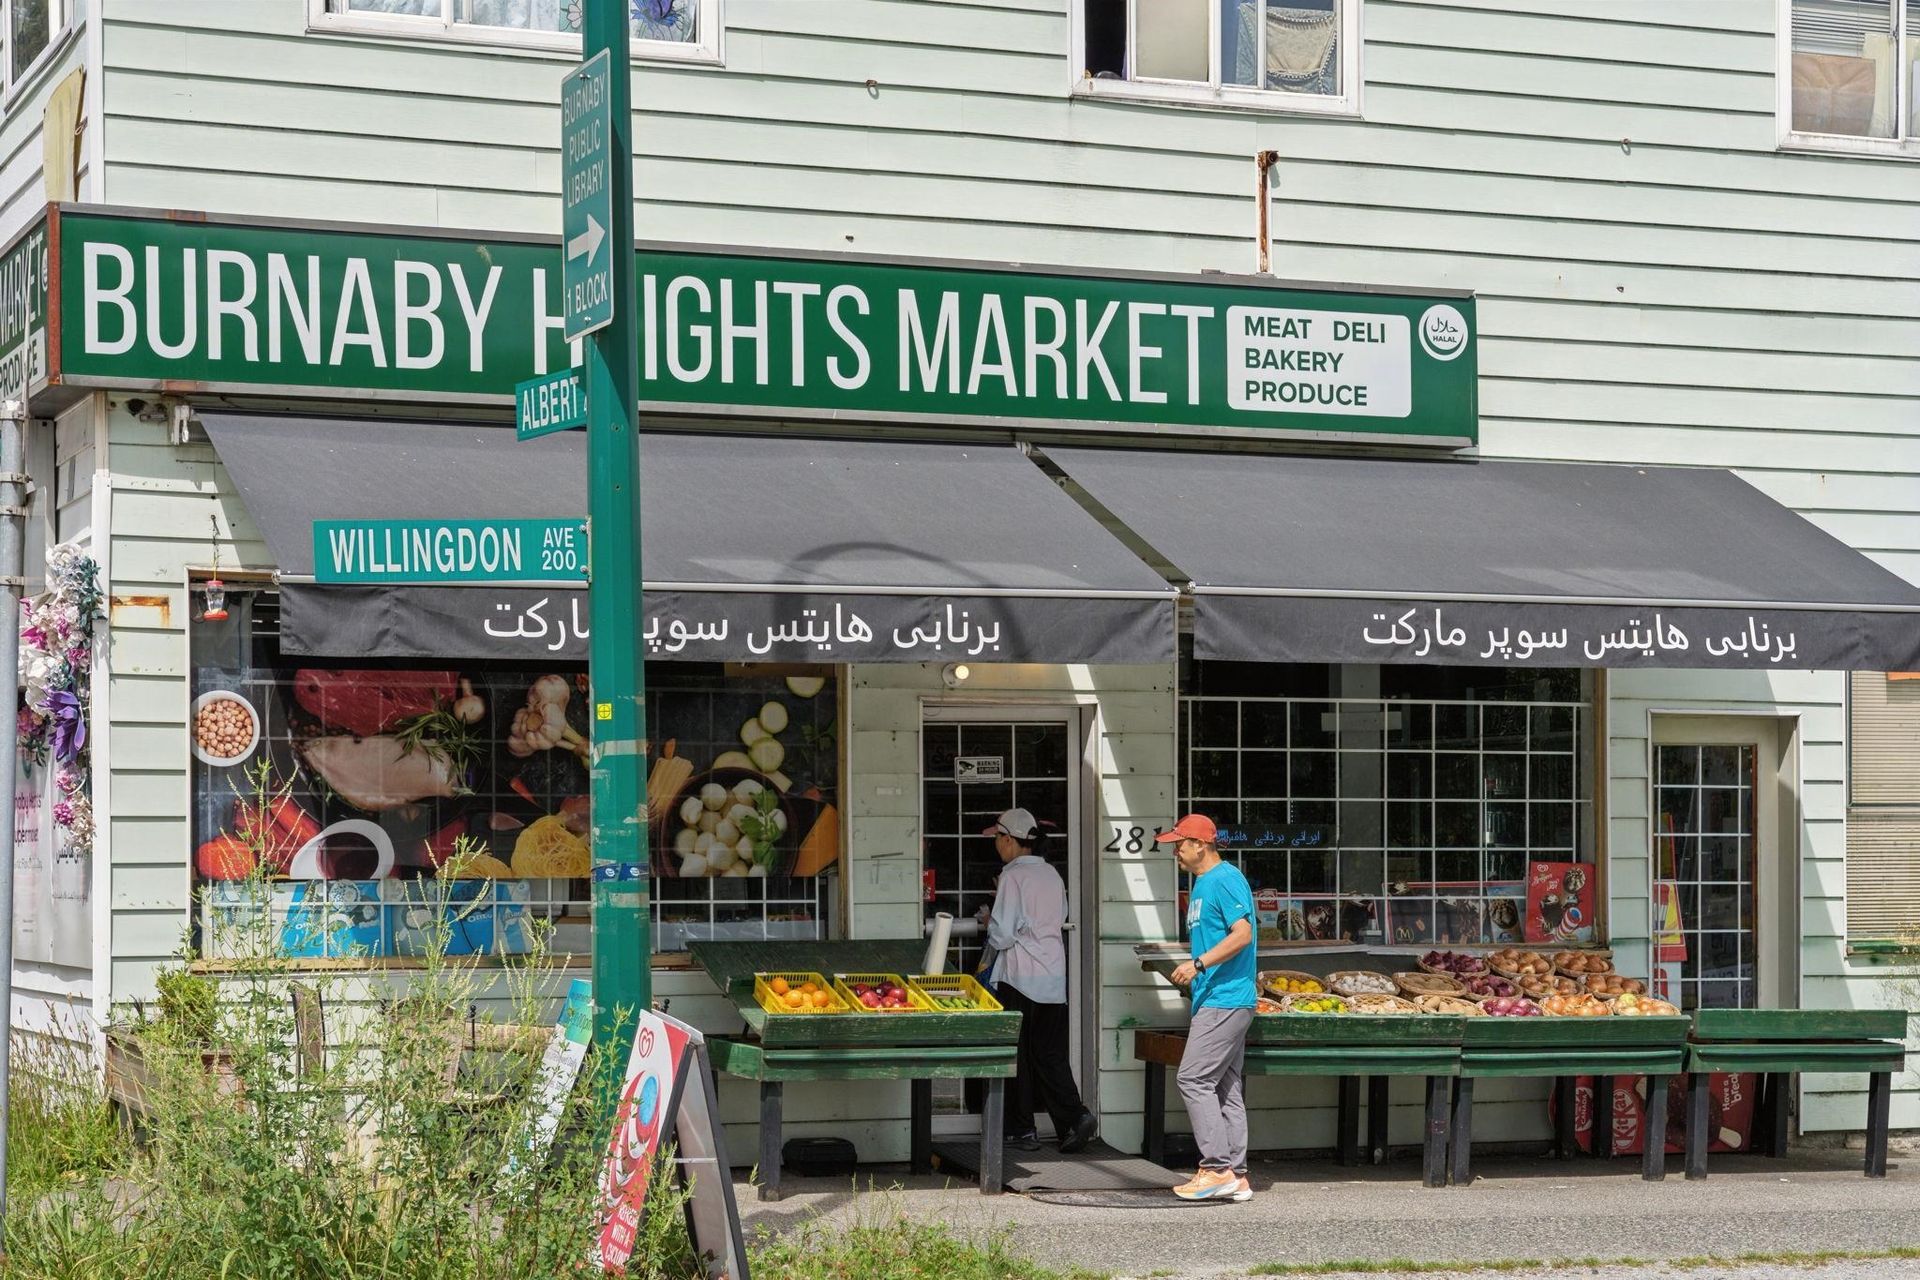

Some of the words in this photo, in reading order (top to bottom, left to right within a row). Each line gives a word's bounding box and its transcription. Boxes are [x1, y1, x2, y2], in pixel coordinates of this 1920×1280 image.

[564, 72, 606, 126] BURNABY
[569, 119, 601, 166] PUBLIC
[567, 159, 605, 209] LIBRARY
[567, 290, 573, 318] 1
[575, 271, 608, 314] BLOCK
[82, 241, 503, 373] BURNABY
[533, 267, 871, 390] HIGHTS
[898, 288, 1214, 405] MARKET
[1243, 315, 1312, 340] MEAT
[1333, 319, 1386, 344] DELI
[1431, 316, 1459, 333] حلال
[1432, 335, 1457, 343] HALAL
[1244, 347, 1344, 373] BAKERY
[522, 376, 579, 431] ALBERT
[1244, 380, 1368, 407] PRODUCE
[328, 526, 521, 574] WILLINGDON
[543, 526, 574, 549] AVE
[541, 549, 577, 572] 200
[483, 597, 590, 651] ارکت
[643, 616, 728, 653] سوپ
[1363, 608, 1466, 657] مارکت
[1480, 627, 1568, 660] سوپر
[1722, 1087, 1730, 1112] Have
